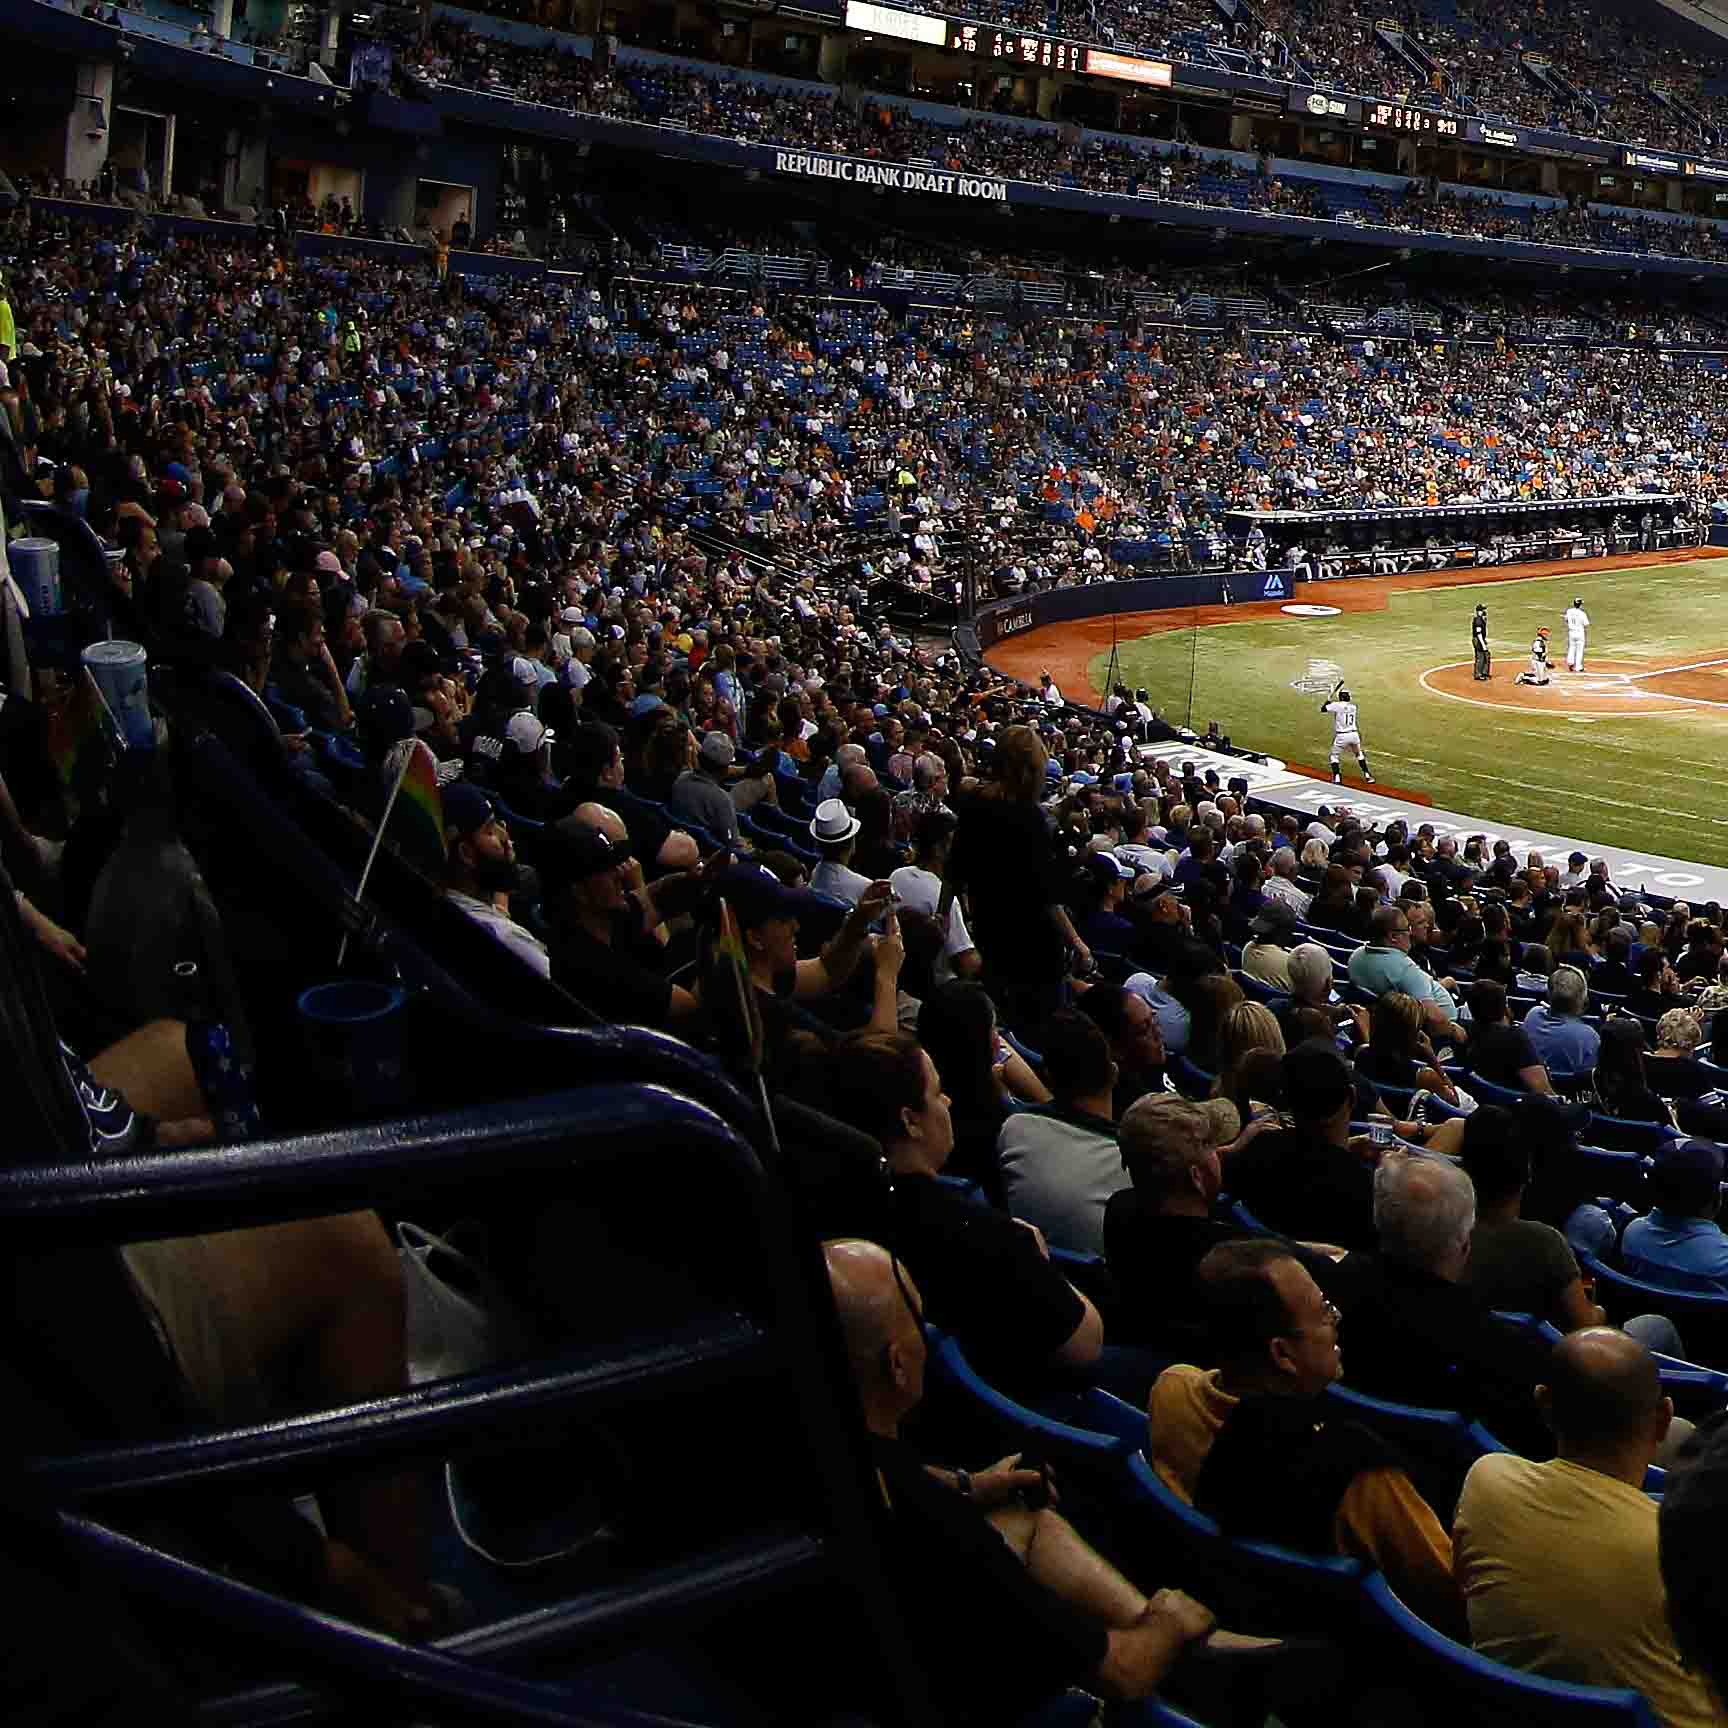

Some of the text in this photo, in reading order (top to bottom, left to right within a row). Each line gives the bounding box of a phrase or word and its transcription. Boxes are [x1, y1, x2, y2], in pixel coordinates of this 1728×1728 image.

[775, 152, 1007, 201] REPUBLIC BANK DRAFT ROOM
[1345, 714, 1354, 725] 13
[1617, 862, 1706, 888] TO
